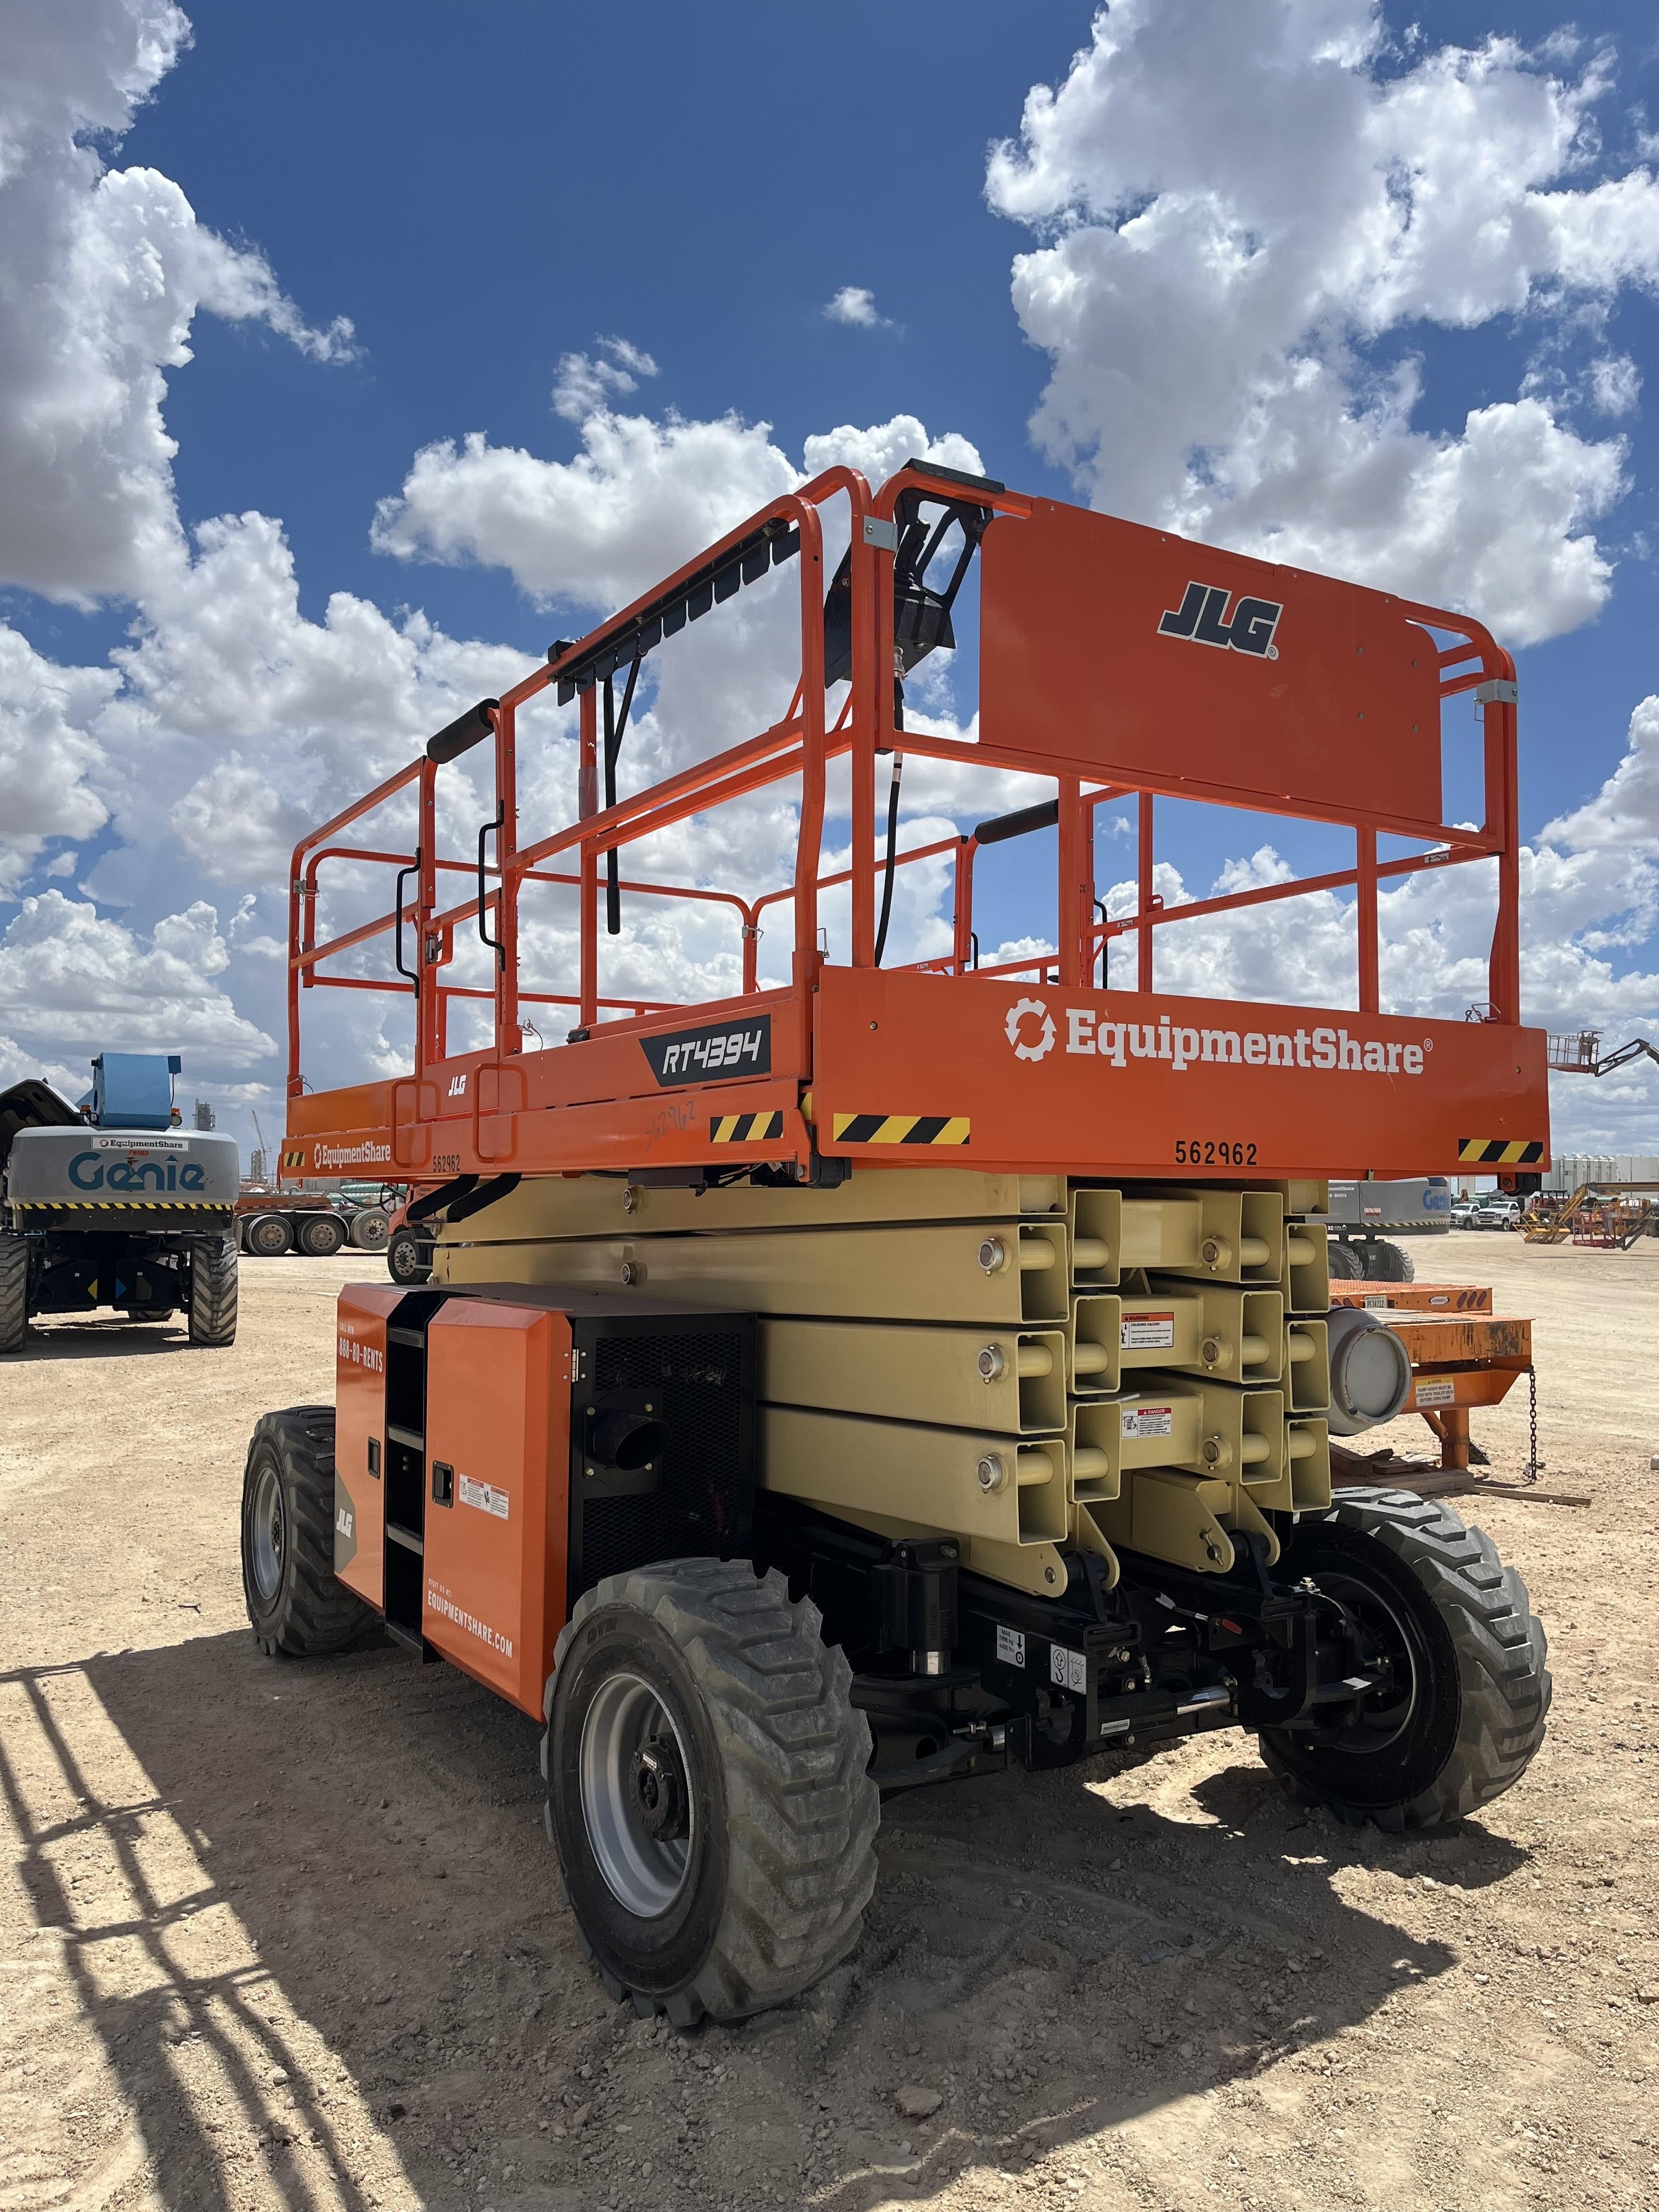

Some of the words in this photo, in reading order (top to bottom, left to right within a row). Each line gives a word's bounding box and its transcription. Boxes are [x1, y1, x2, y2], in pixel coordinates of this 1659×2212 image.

[662, 1030, 762, 1074] RT4394
[448, 1075, 467, 1097] JLG
[110, 1140, 183, 1149] EquipmentShare
[322, 1141, 391, 1169] EquipmentShare
[1175, 1141, 1257, 1165] 562962
[68, 1152, 205, 1190] Genie
[433, 1154, 460, 1172] 562962
[339, 1336, 383, 1373] 888-80-RENTS
[336, 1508, 353, 1538] JLG
[428, 1577, 438, 1589] VISIT
[439, 1584, 445, 1594] US
[427, 1590, 512, 1658] EQUIPMENTSHARE.COM
[1001, 1629, 1011, 1638] MAX
